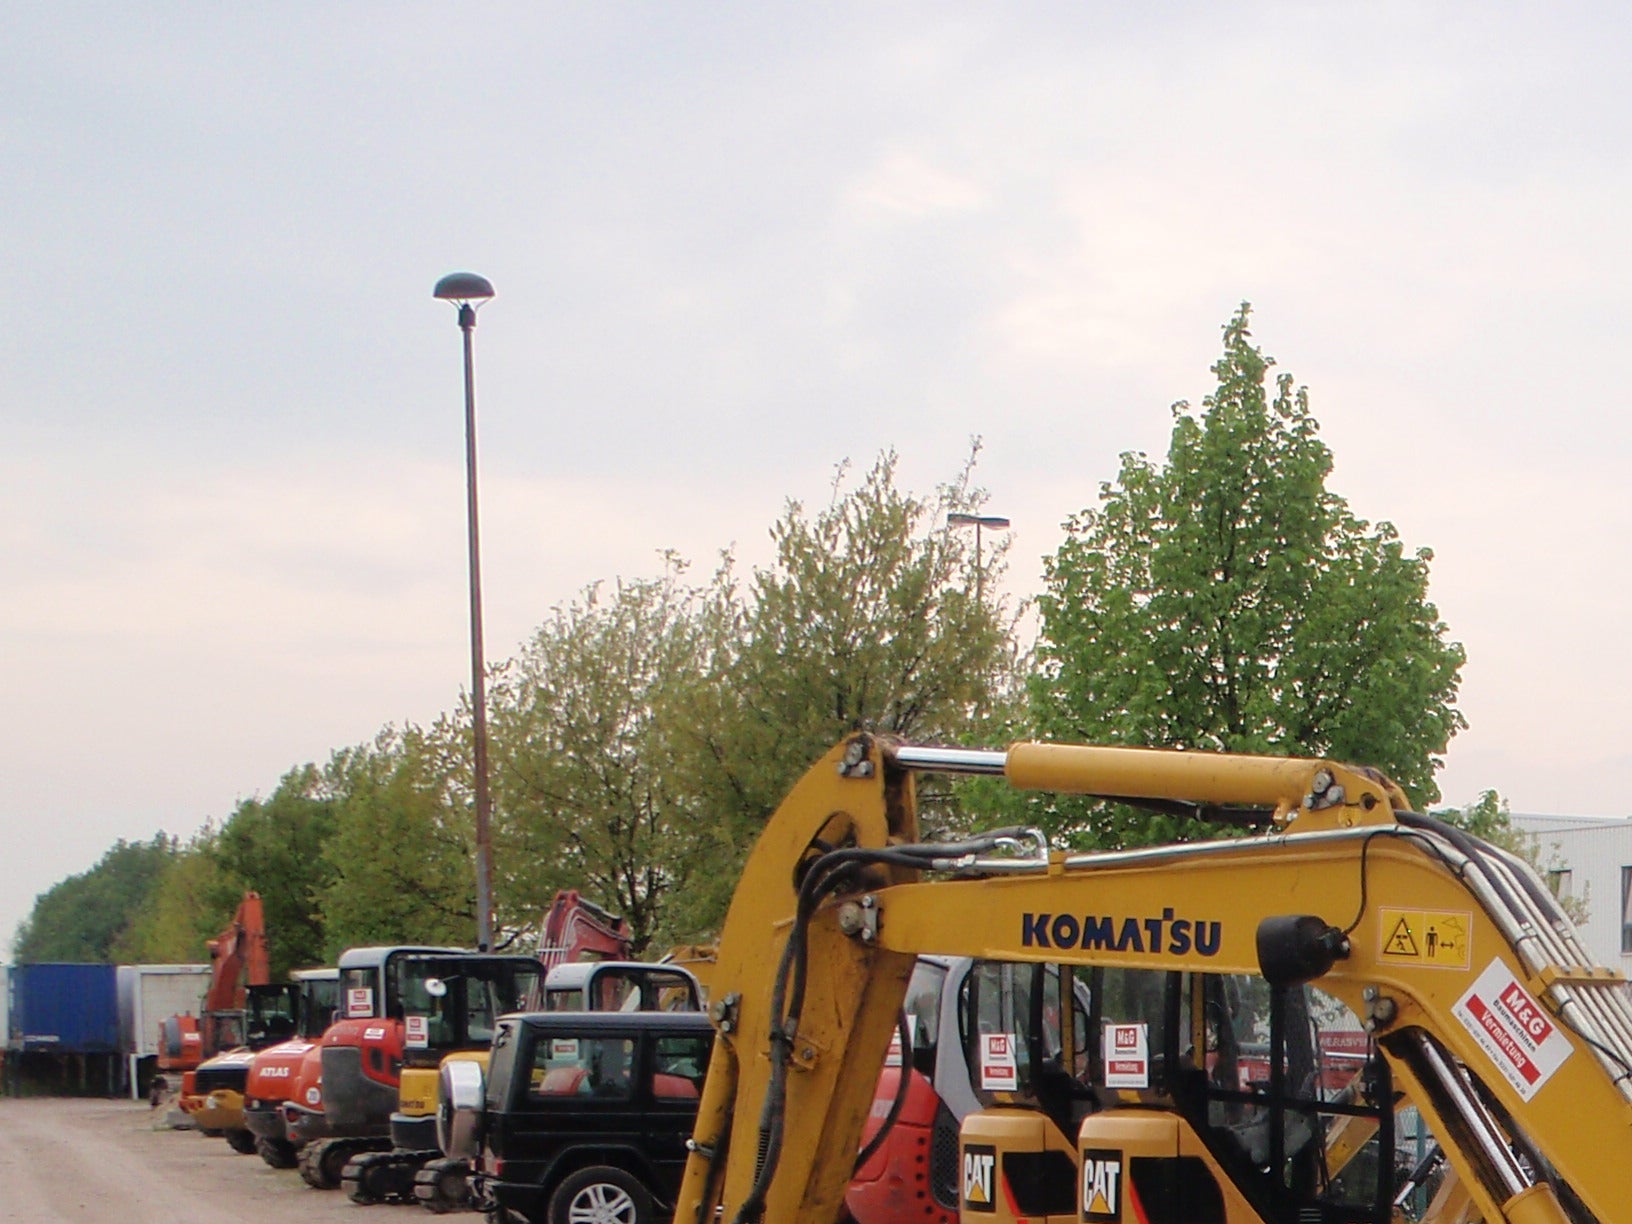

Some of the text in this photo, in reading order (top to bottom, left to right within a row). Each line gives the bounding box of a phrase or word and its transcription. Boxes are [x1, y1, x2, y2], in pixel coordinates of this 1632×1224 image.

[1022, 907, 1221, 957] KOMATSU
[1492, 999, 1536, 1053] Baumaschinen
[1504, 988, 1545, 1037] M&G
[1480, 1010, 1528, 1069] Vermietung
[259, 1067, 289, 1077] ATLAS
[963, 1151, 994, 1203] CAT
[1083, 1158, 1120, 1214] CAT
